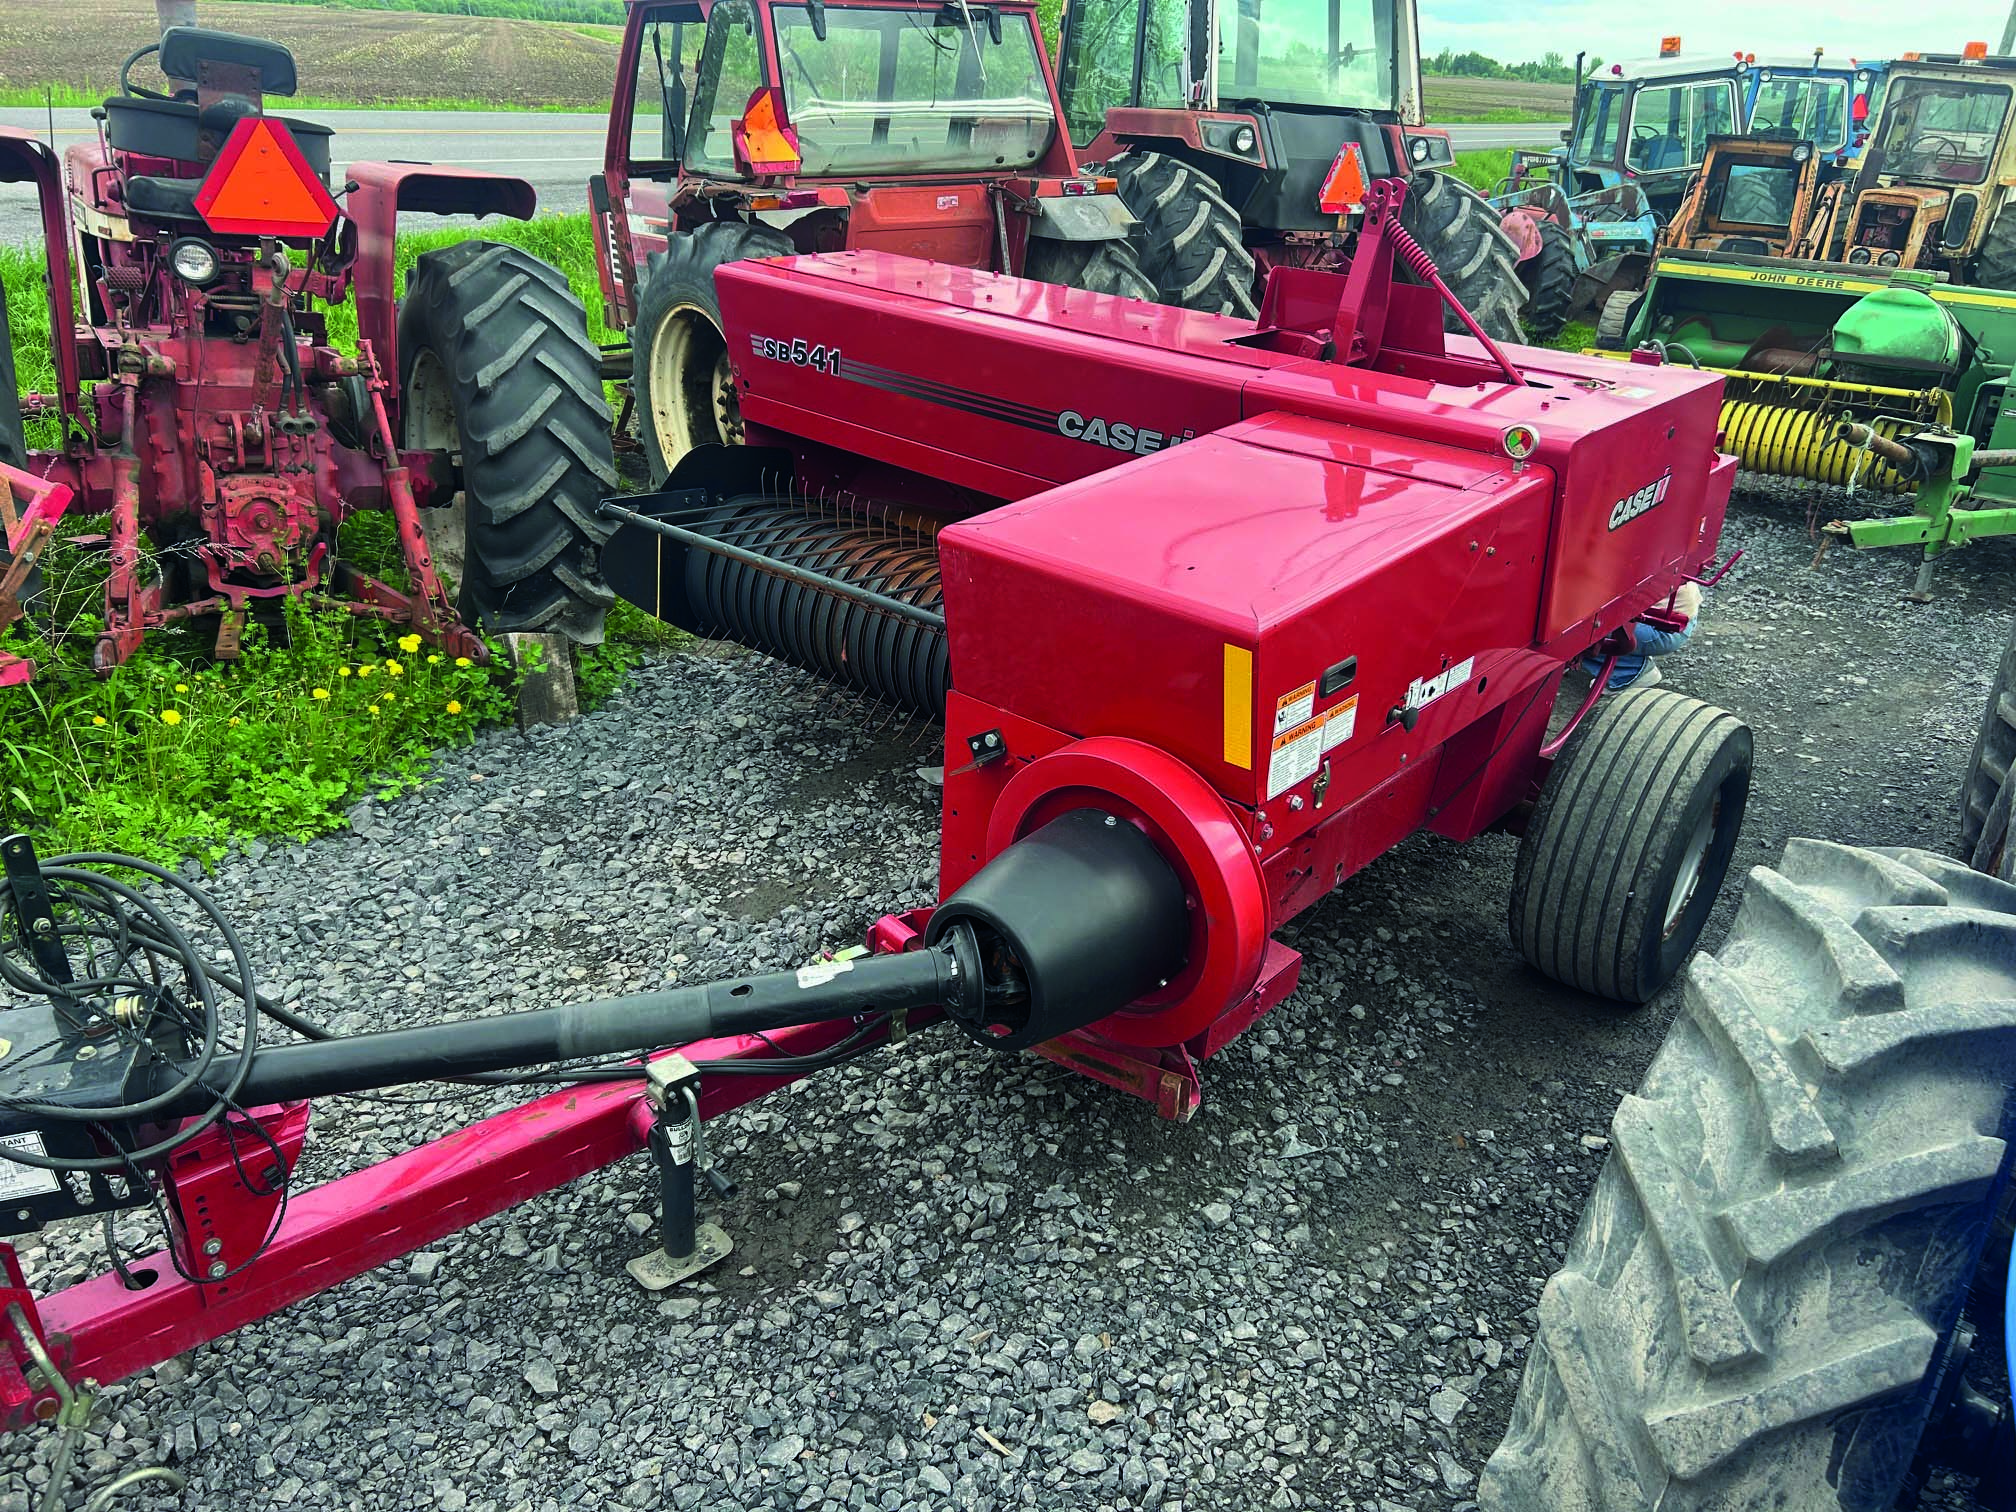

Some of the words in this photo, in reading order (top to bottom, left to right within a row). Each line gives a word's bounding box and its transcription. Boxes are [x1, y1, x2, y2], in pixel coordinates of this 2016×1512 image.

[1750, 273, 1787, 283] JOHN
[1796, 277, 1845, 289] DEERE
[763, 337, 841, 377] SB541
[1057, 410, 1163, 456] CASE
[1288, 721, 1316, 740] WARNING
[0, 1136, 26, 1146] TANT
